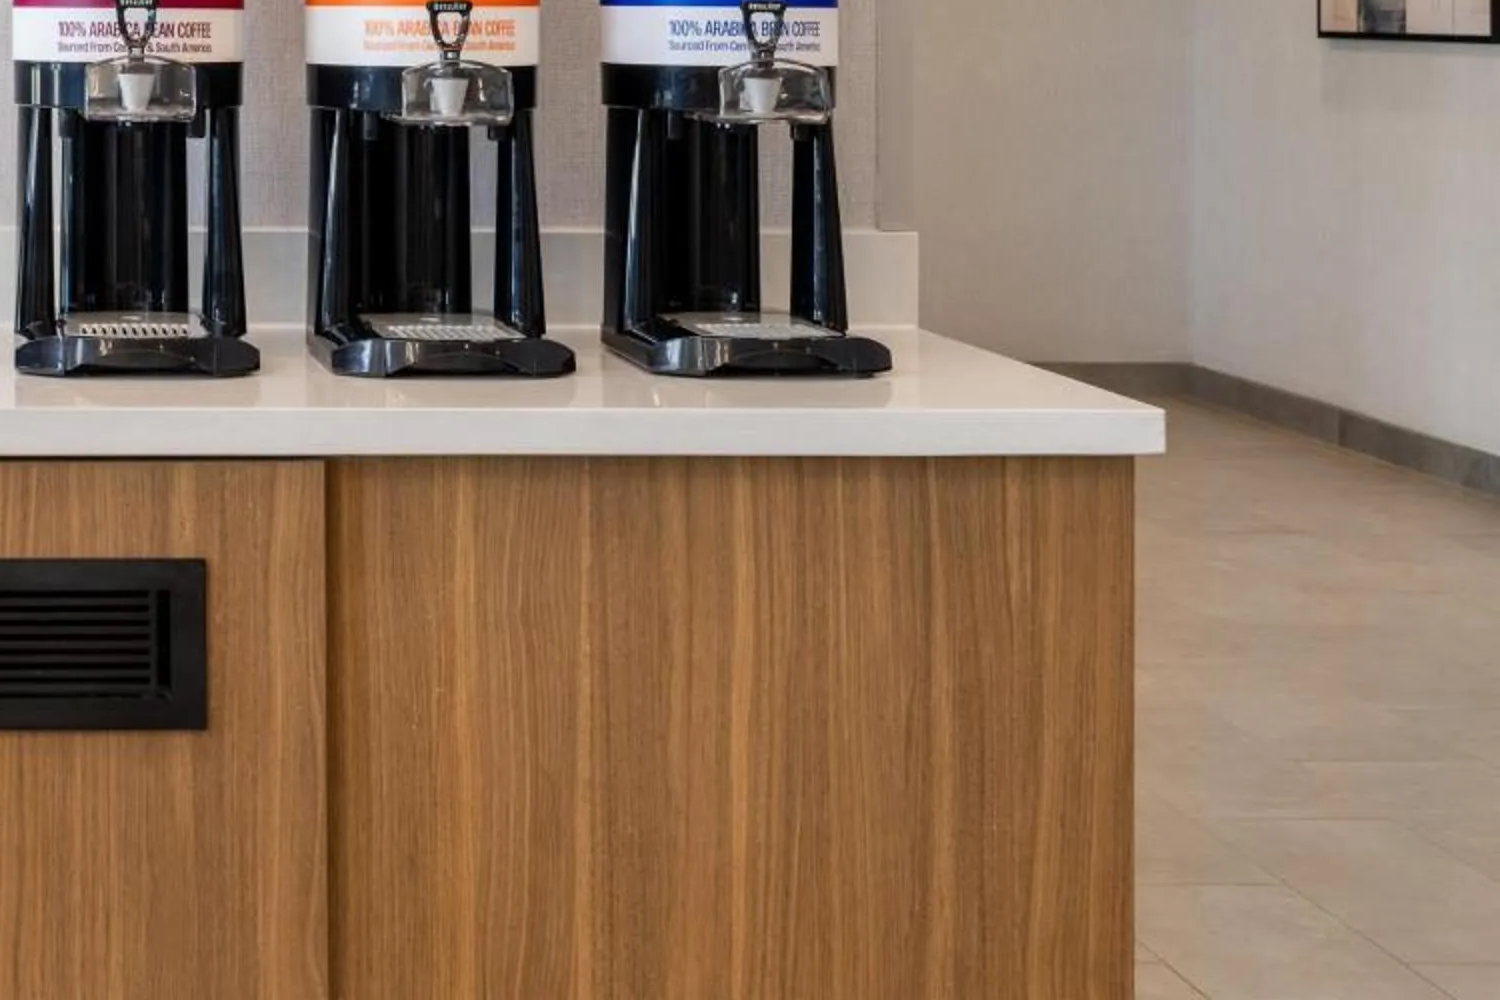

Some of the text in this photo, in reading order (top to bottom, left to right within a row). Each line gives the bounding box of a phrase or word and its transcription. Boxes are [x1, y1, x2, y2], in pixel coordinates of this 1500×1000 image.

[177, 21, 212, 38] COFFEE
[669, 20, 702, 37] 100%
[791, 20, 821, 37] COFFEE
